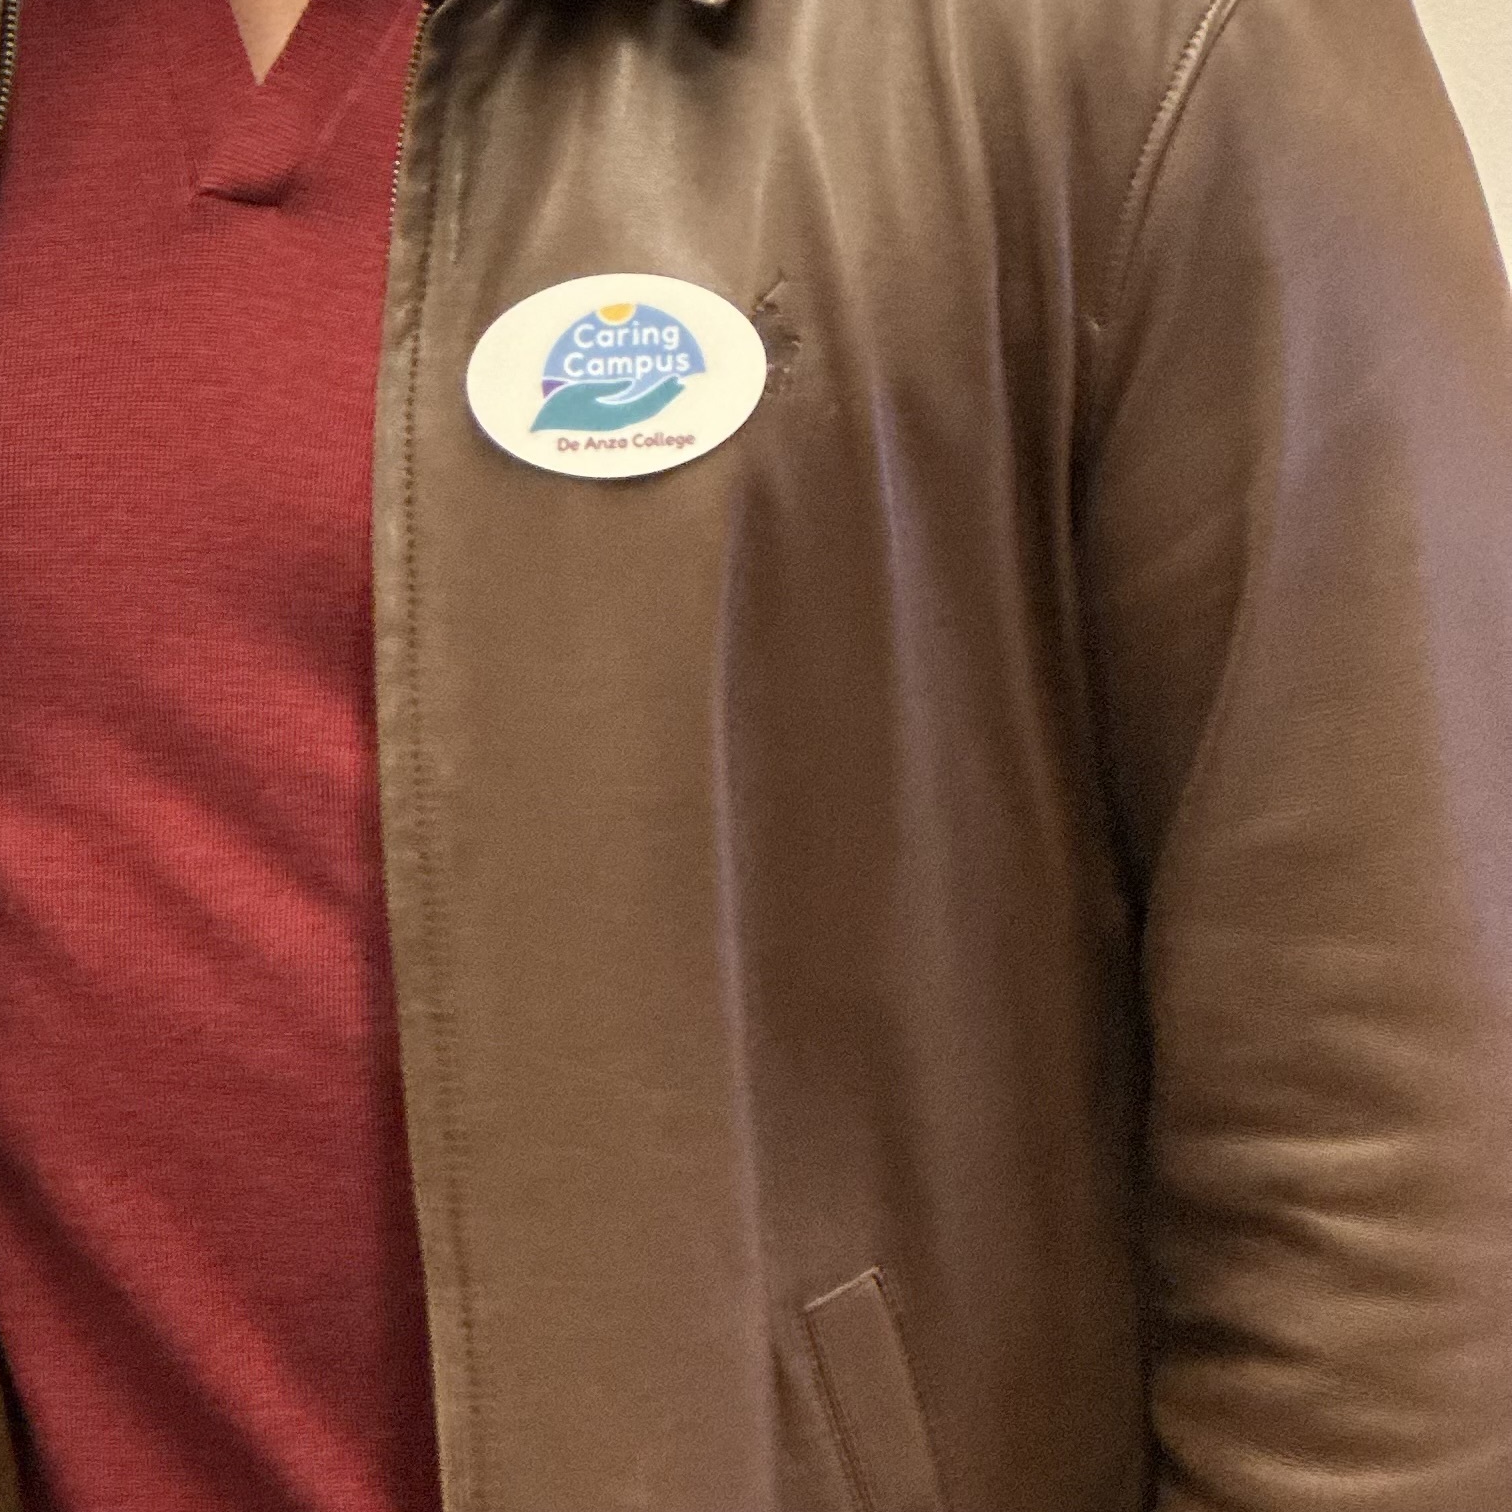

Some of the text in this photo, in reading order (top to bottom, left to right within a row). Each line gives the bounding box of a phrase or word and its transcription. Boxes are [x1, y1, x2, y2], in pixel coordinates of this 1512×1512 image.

[573, 321, 680, 350] Caring
[563, 352, 690, 379] Campus
[557, 432, 696, 451] De Anza College
